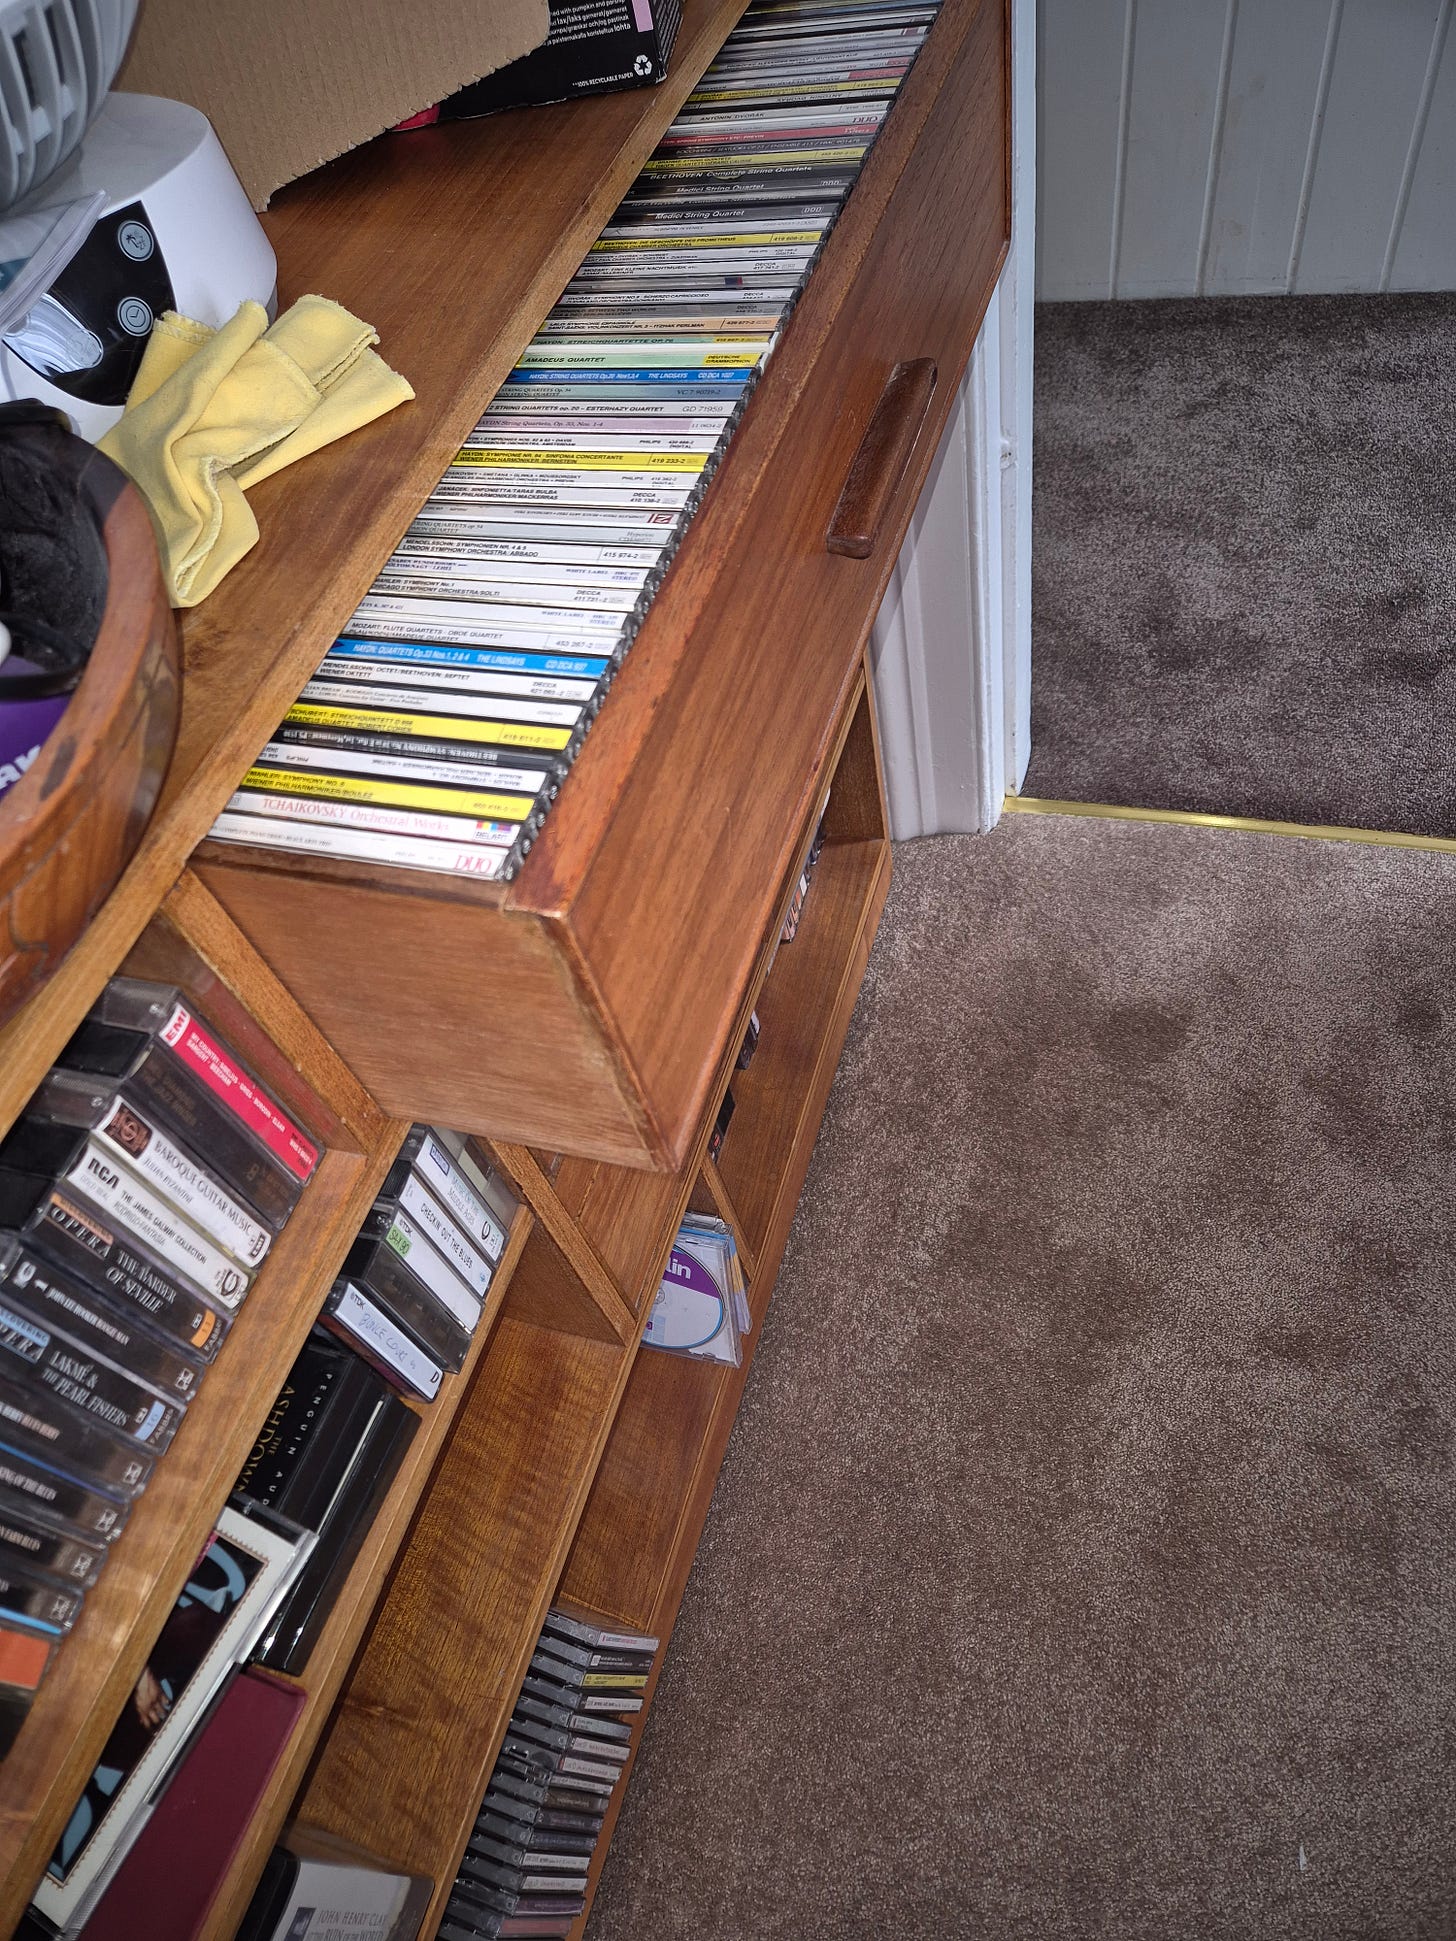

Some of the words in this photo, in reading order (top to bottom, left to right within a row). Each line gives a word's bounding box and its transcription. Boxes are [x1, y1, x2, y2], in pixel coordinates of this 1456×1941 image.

[613, 23, 631, 32] lohta
[589, 75, 619, 85] RECYCLABLE
[618, 71, 634, 80] PAPER
[650, 172, 703, 180] BEETHOVEN
[732, 183, 765, 191] Quartet
[654, 212, 683, 220] Medici
[684, 211, 711, 219] String
[378, 646, 414, 657] QUARTETS
[476, 653, 491, 664] THE
[491, 655, 526, 667] LINDSAYS
[286, 715, 322, 724] AMADEUS
[322, 718, 354, 727] QUARTET
[290, 708, 328, 717] SCHUBERT:
[282, 774, 325, 785] SYMPHONY
[262, 797, 349, 819] TCHAIKOVSKY
[350, 810, 408, 828] Orchestral
[453, 854, 493, 874] DUO
[165, 1010, 189, 1042] EMI
[271, 1117, 286, 1133] ELGAR
[87, 1157, 121, 1189] RCA
[154, 1139, 200, 1184] BAROQUE
[194, 1175, 229, 1214] GUITAR
[226, 1207, 253, 1237] MUSIC
[50, 1206, 113, 1259] OPERA
[120, 1191, 135, 1205] THE
[132, 1199, 154, 1221] JAMES
[173, 1232, 208, 1265] COLLECTION
[440, 1226, 452, 1242] OUT
[449, 1237, 460, 1254] THE
[457, 1249, 474, 1270] BLUES
[117, 1249, 141, 1276] THE
[137, 1266, 178, 1305] BARBER
[105, 1266, 127, 1286] OF
[121, 1278, 165, 1314] SEVILLE
[353, 1294, 366, 1311] TDK
[53, 1373, 90, 1404] PEARL
[87, 1395, 131, 1427] FISHERS
[287, 1373, 333, 1456] PENGUIN
[318, 1909, 341, 1925] JOHN
[341, 1910, 369, 1925] HENRY
